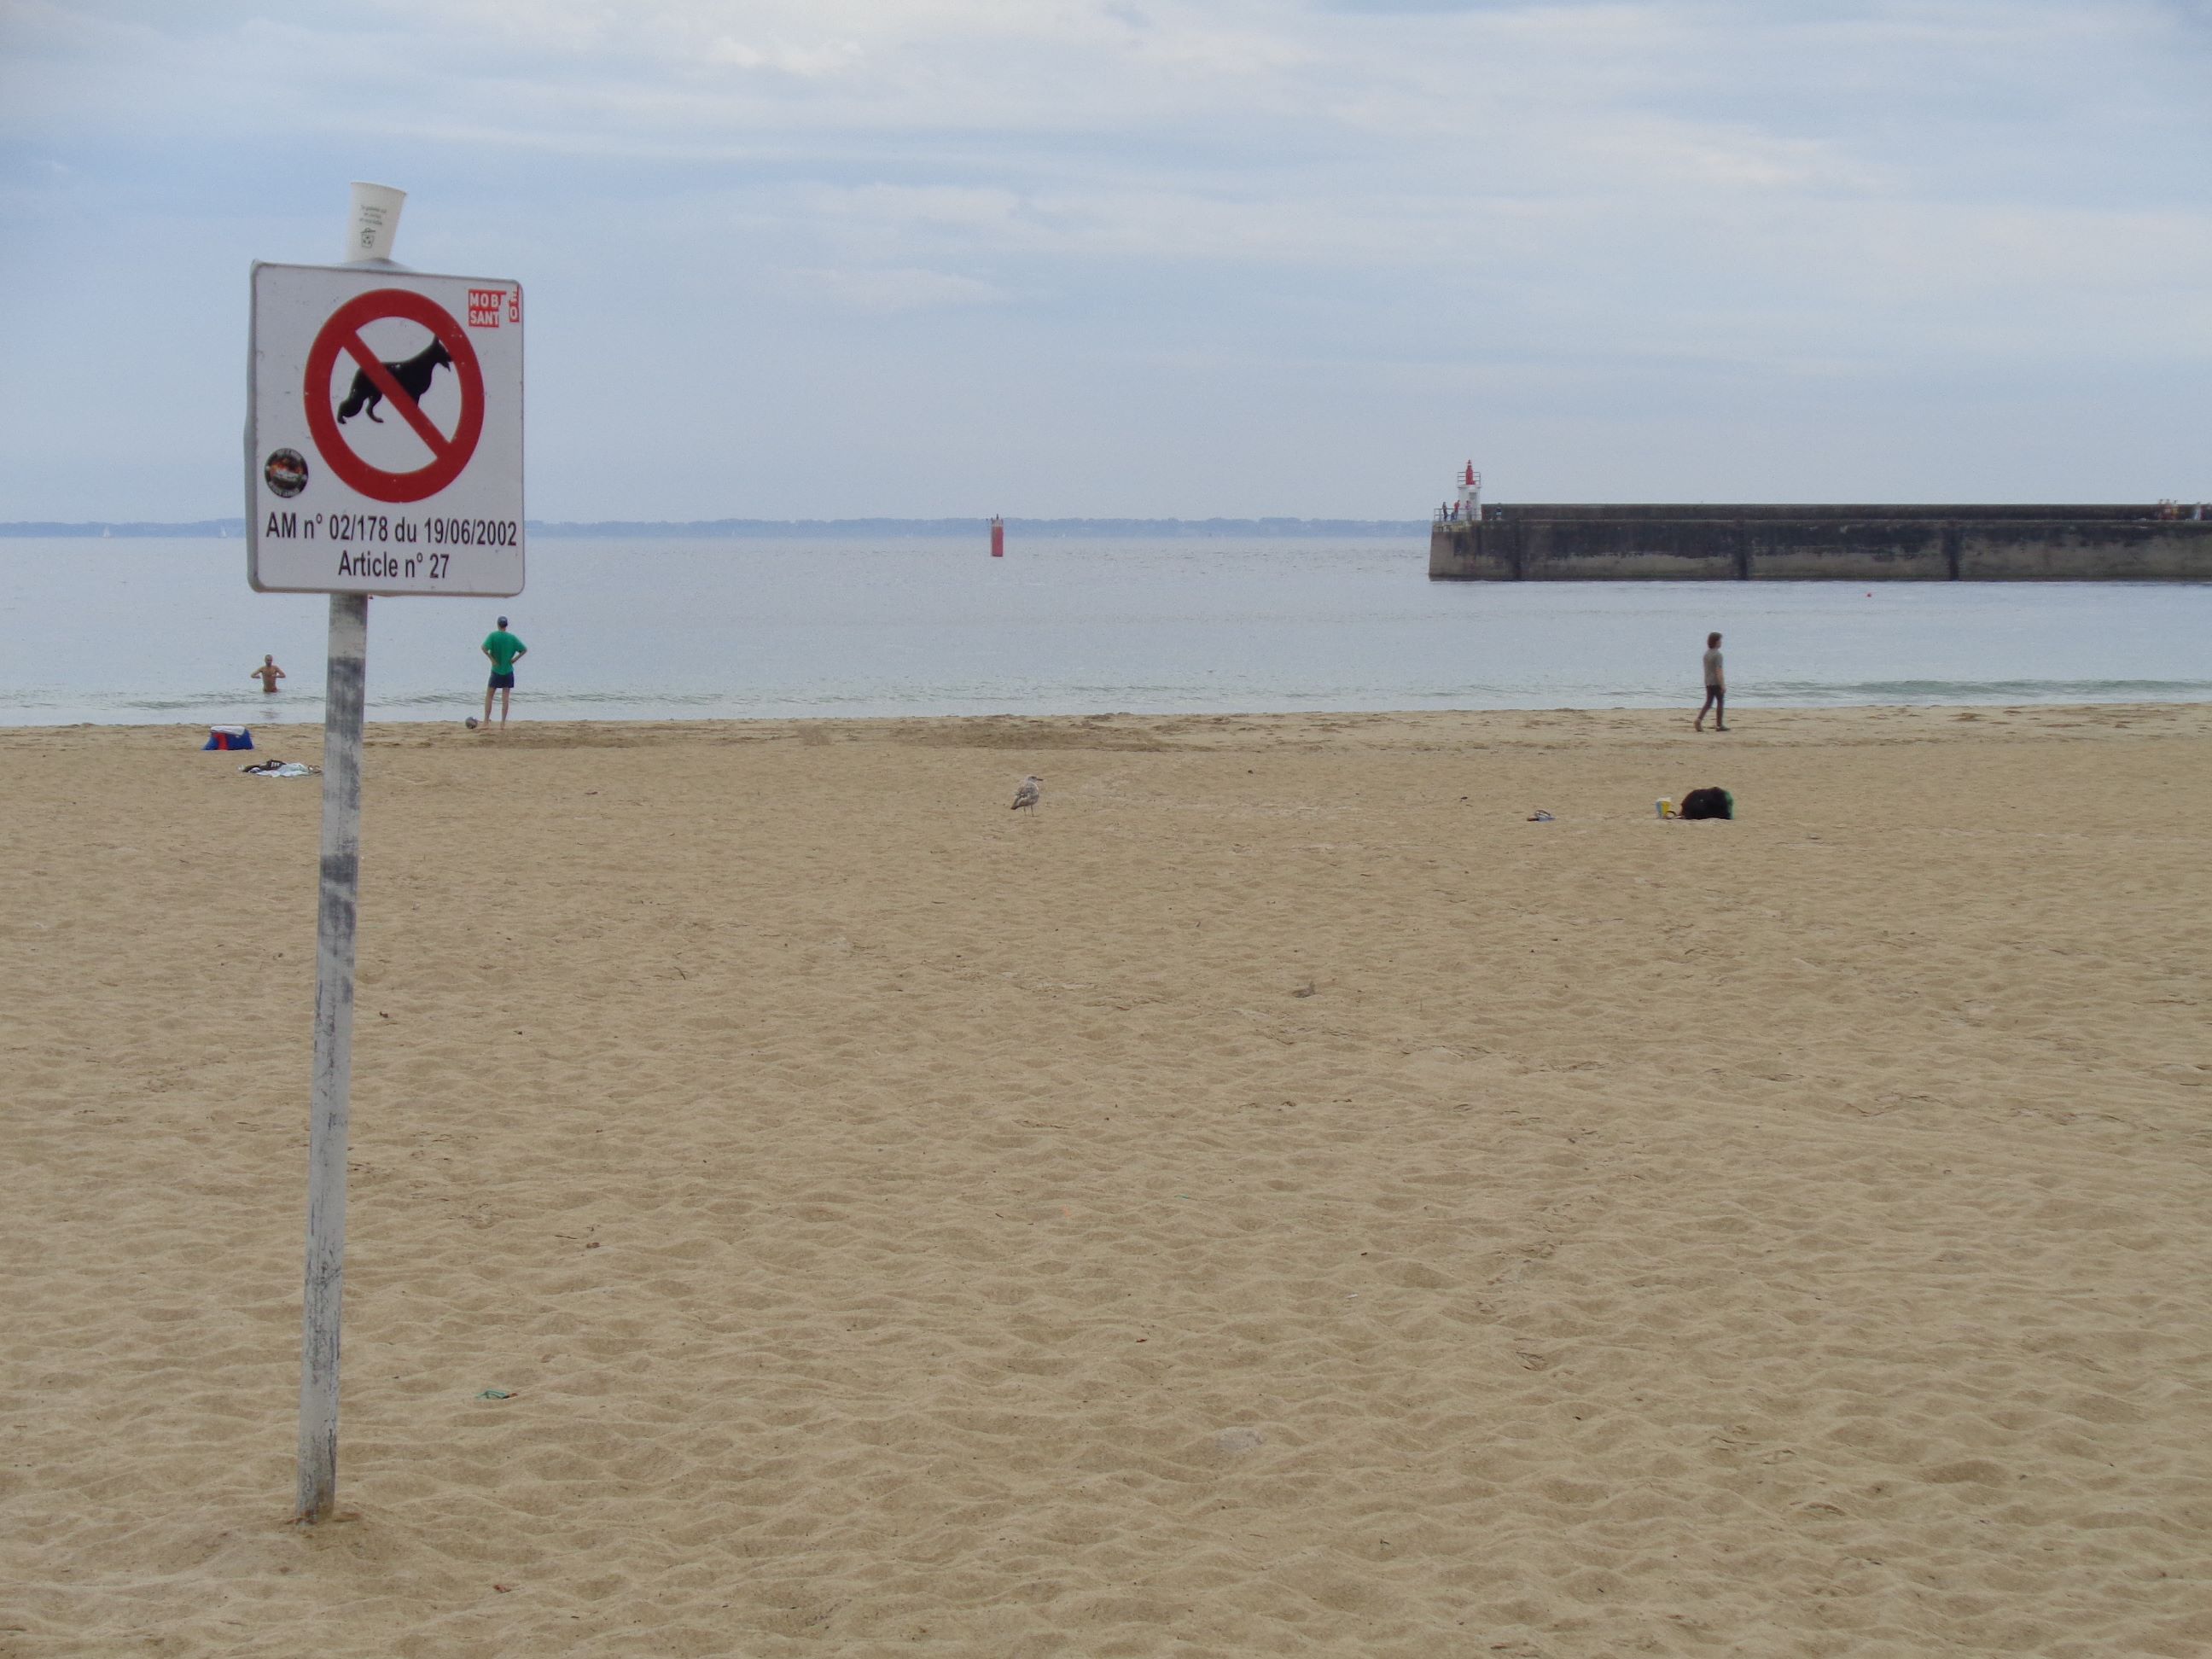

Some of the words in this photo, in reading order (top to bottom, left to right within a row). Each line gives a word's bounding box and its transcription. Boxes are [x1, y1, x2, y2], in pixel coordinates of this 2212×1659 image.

[265, 511, 297, 539] AM
[304, 514, 323, 539] n°
[329, 514, 388, 542] 02/178
[394, 516, 417, 544] du
[424, 517, 517, 547] 19/06/2002
[338, 550, 399, 578] Article
[405, 553, 423, 578] n°
[429, 553, 450, 579] 27
